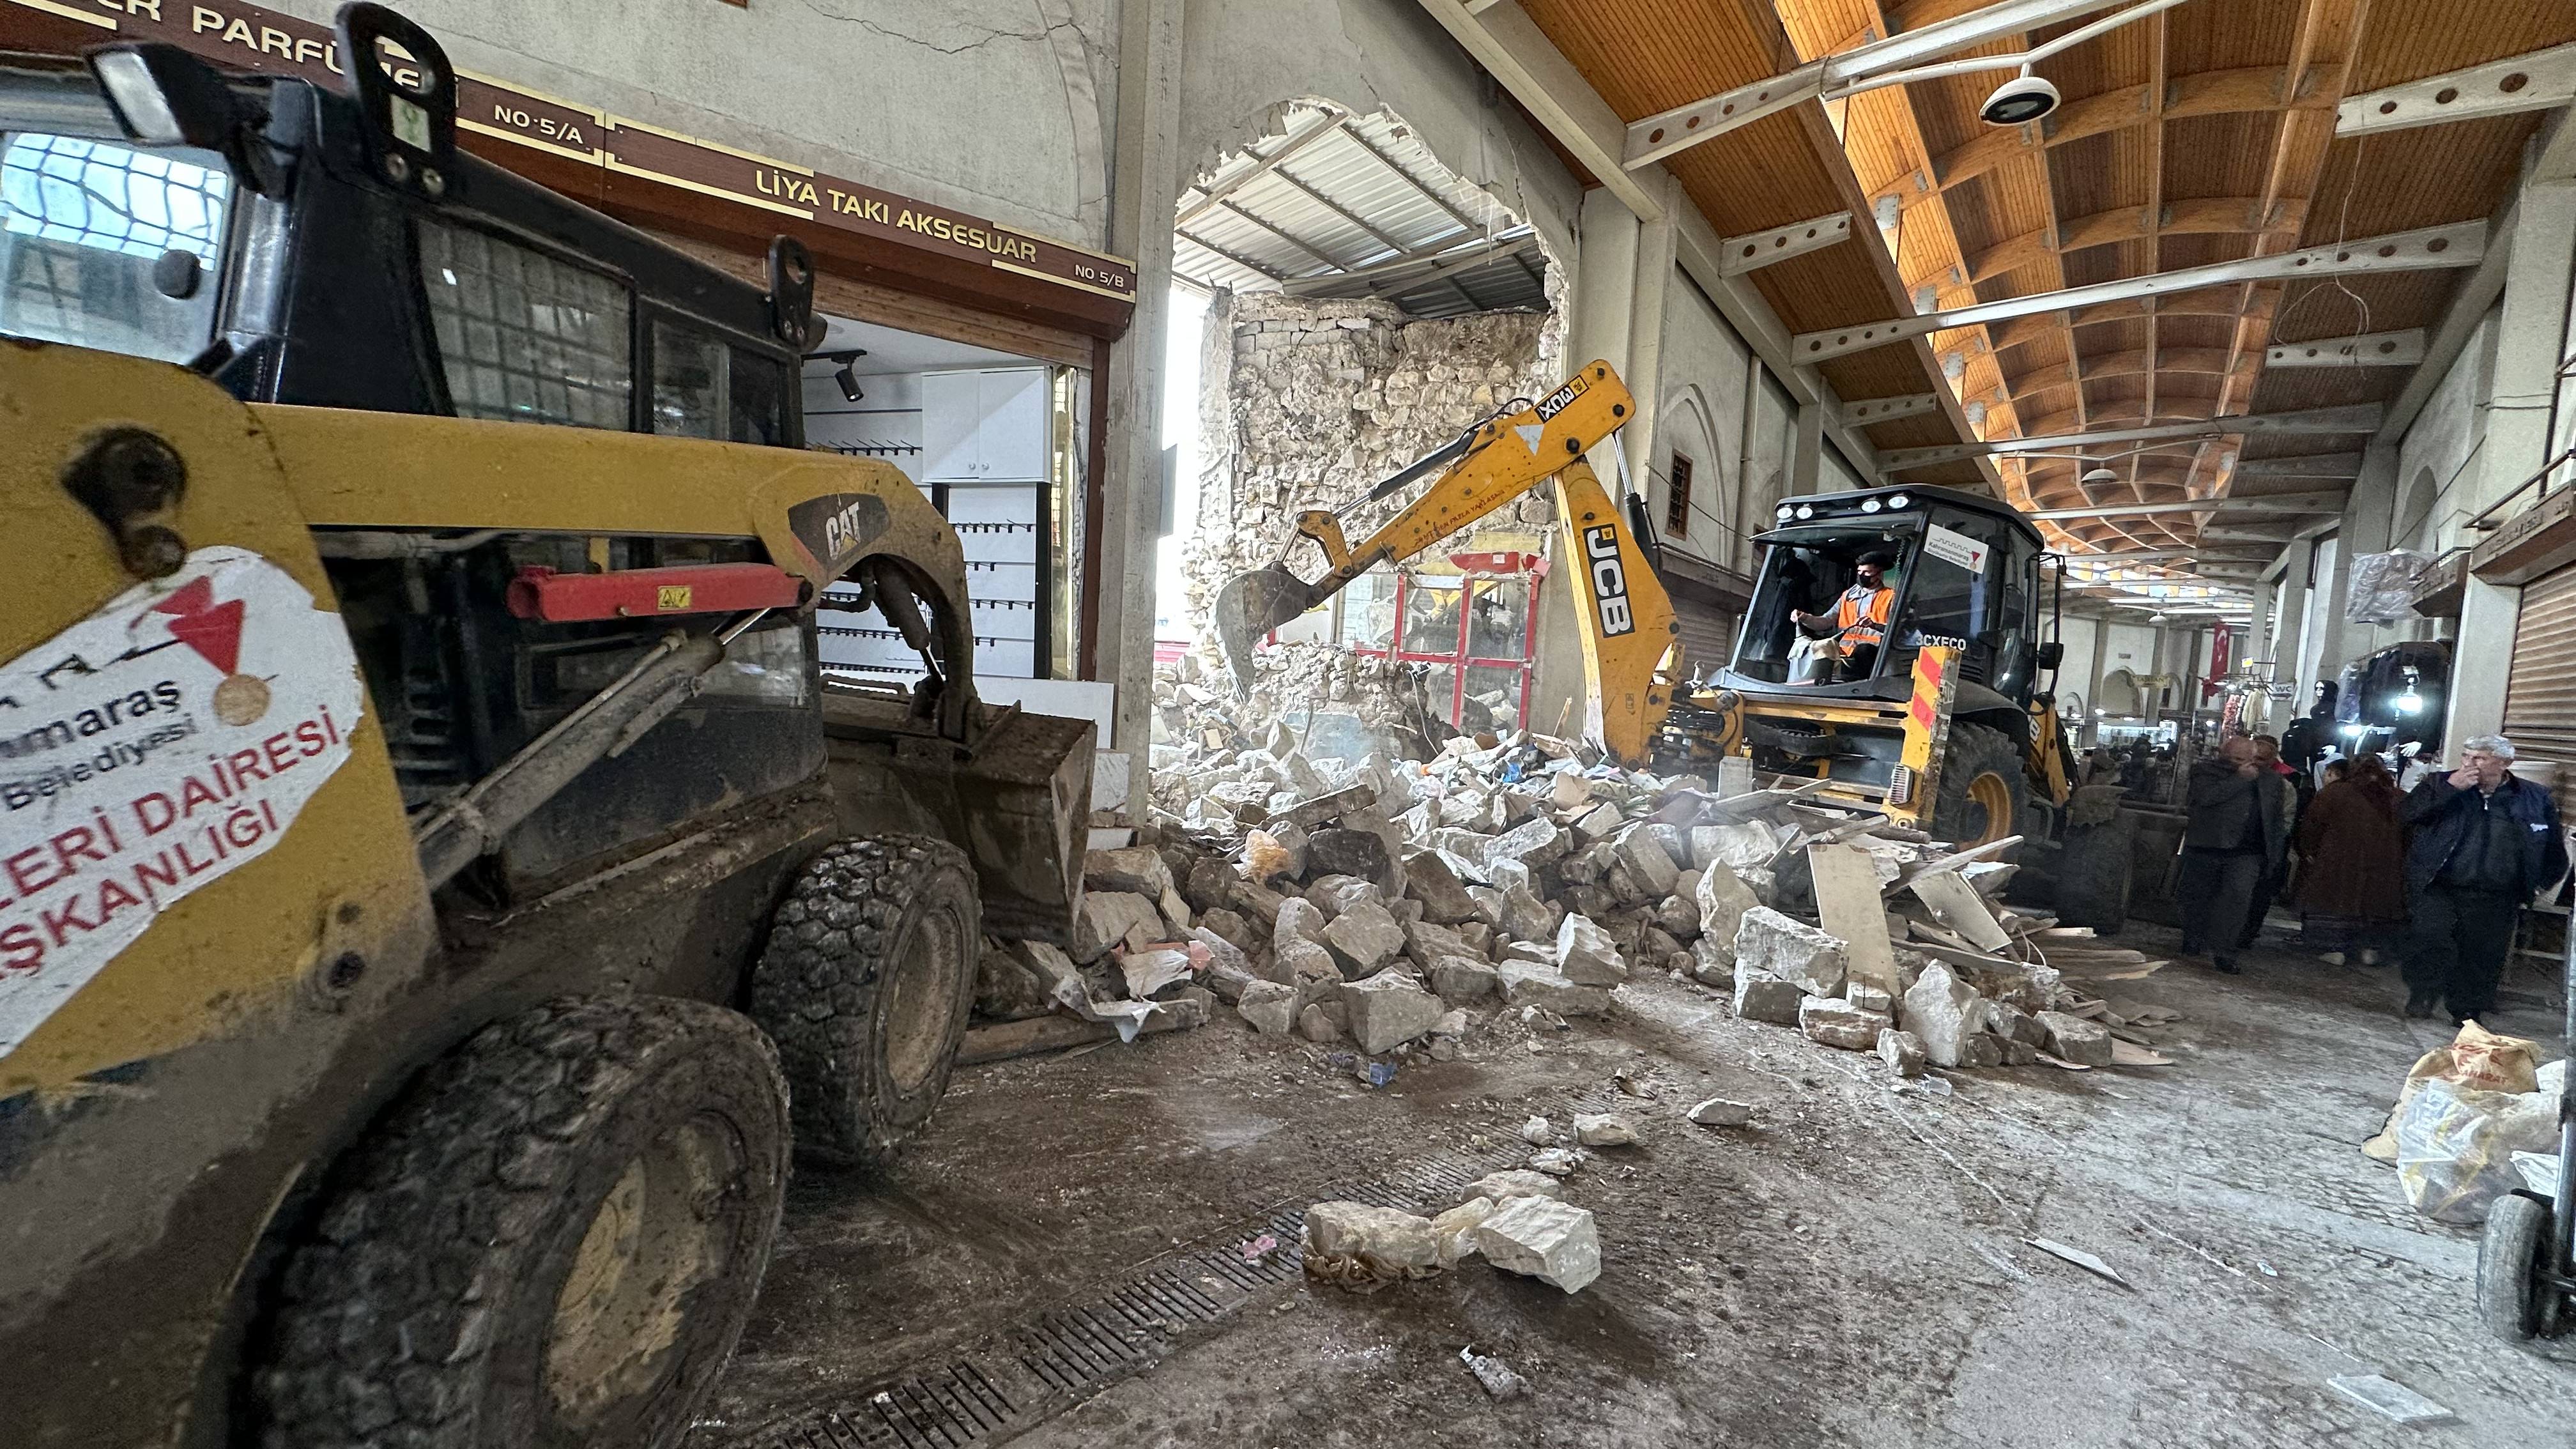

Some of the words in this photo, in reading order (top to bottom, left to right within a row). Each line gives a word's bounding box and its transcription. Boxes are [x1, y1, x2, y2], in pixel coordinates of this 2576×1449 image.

[756, 169, 820, 206] LİYA
[827, 189, 889, 224] TAKI
[896, 210, 1036, 263] AKSESUAR
[1075, 264, 1094, 279] NO
[1100, 272, 1124, 288] 5/B
[1538, 387, 1575, 419] 3CX
[826, 502, 861, 560] CAT
[1587, 529, 1631, 634] JCB
[130, 704, 339, 838] DAİRESİ
